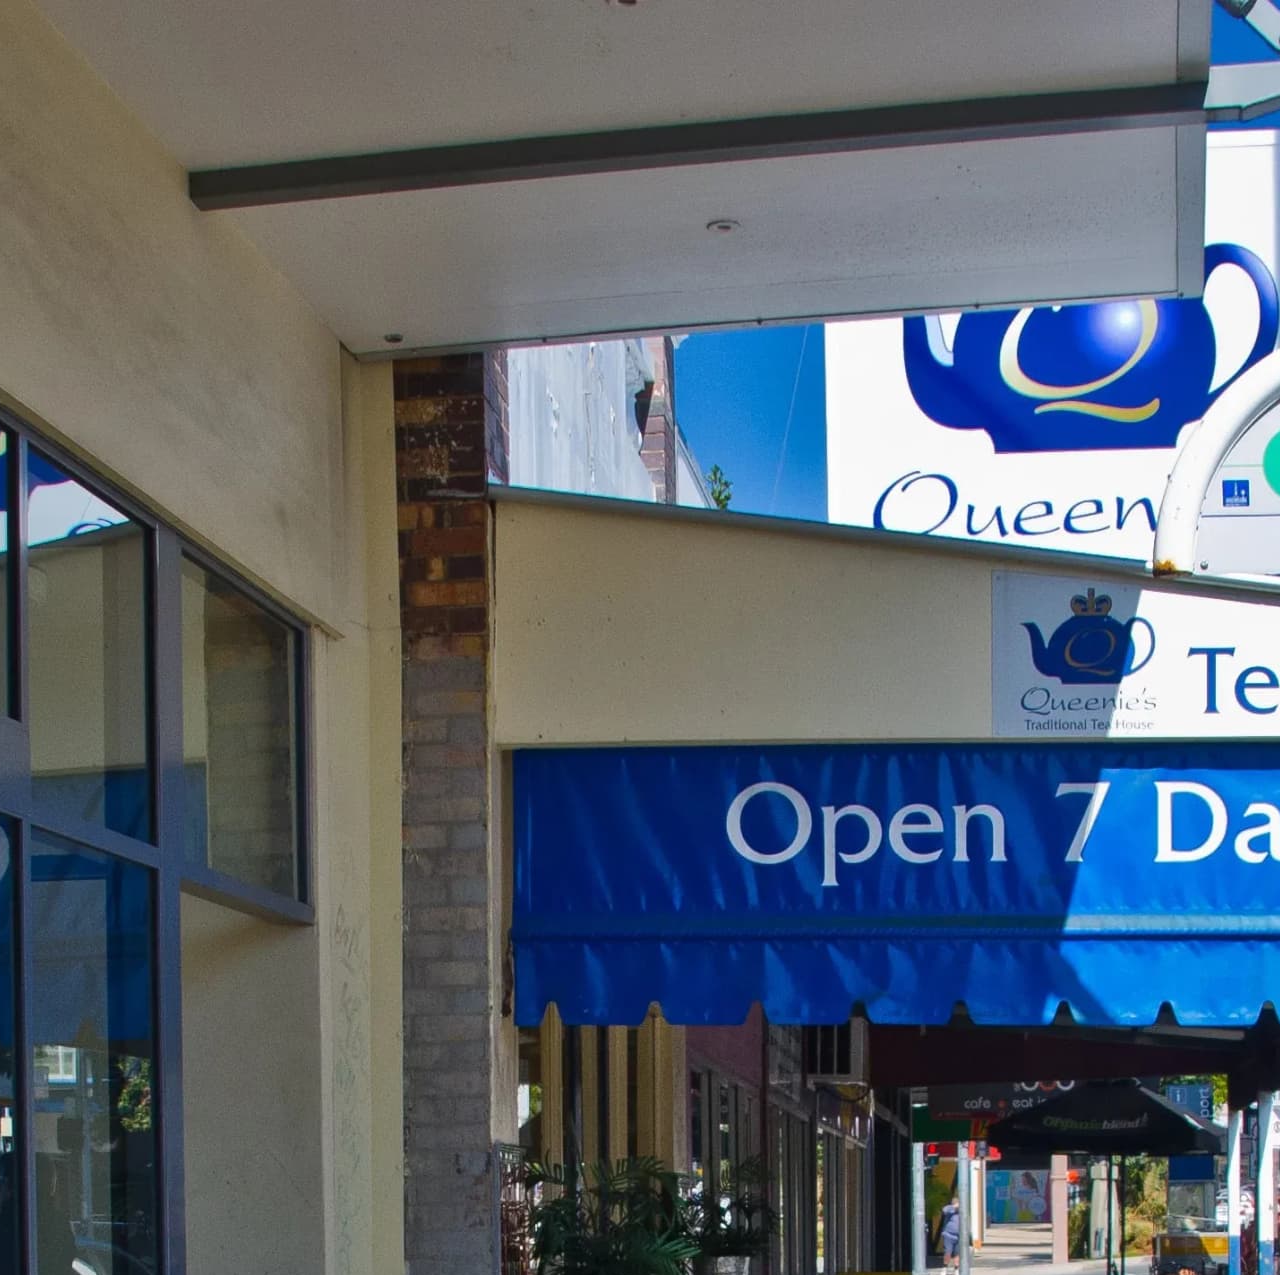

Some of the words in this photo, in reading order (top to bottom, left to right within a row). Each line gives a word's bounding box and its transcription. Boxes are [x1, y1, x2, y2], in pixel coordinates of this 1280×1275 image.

[872, 470, 1158, 538] Queen
[1021, 687, 1157, 716] Queenie's
[1024, 719, 1087, 730] Traditional
[1091, 719, 1112, 730] Tea
[1115, 719, 1155, 730] House
[726, 781, 1008, 887] Open
[1055, 782, 1108, 863] 7
